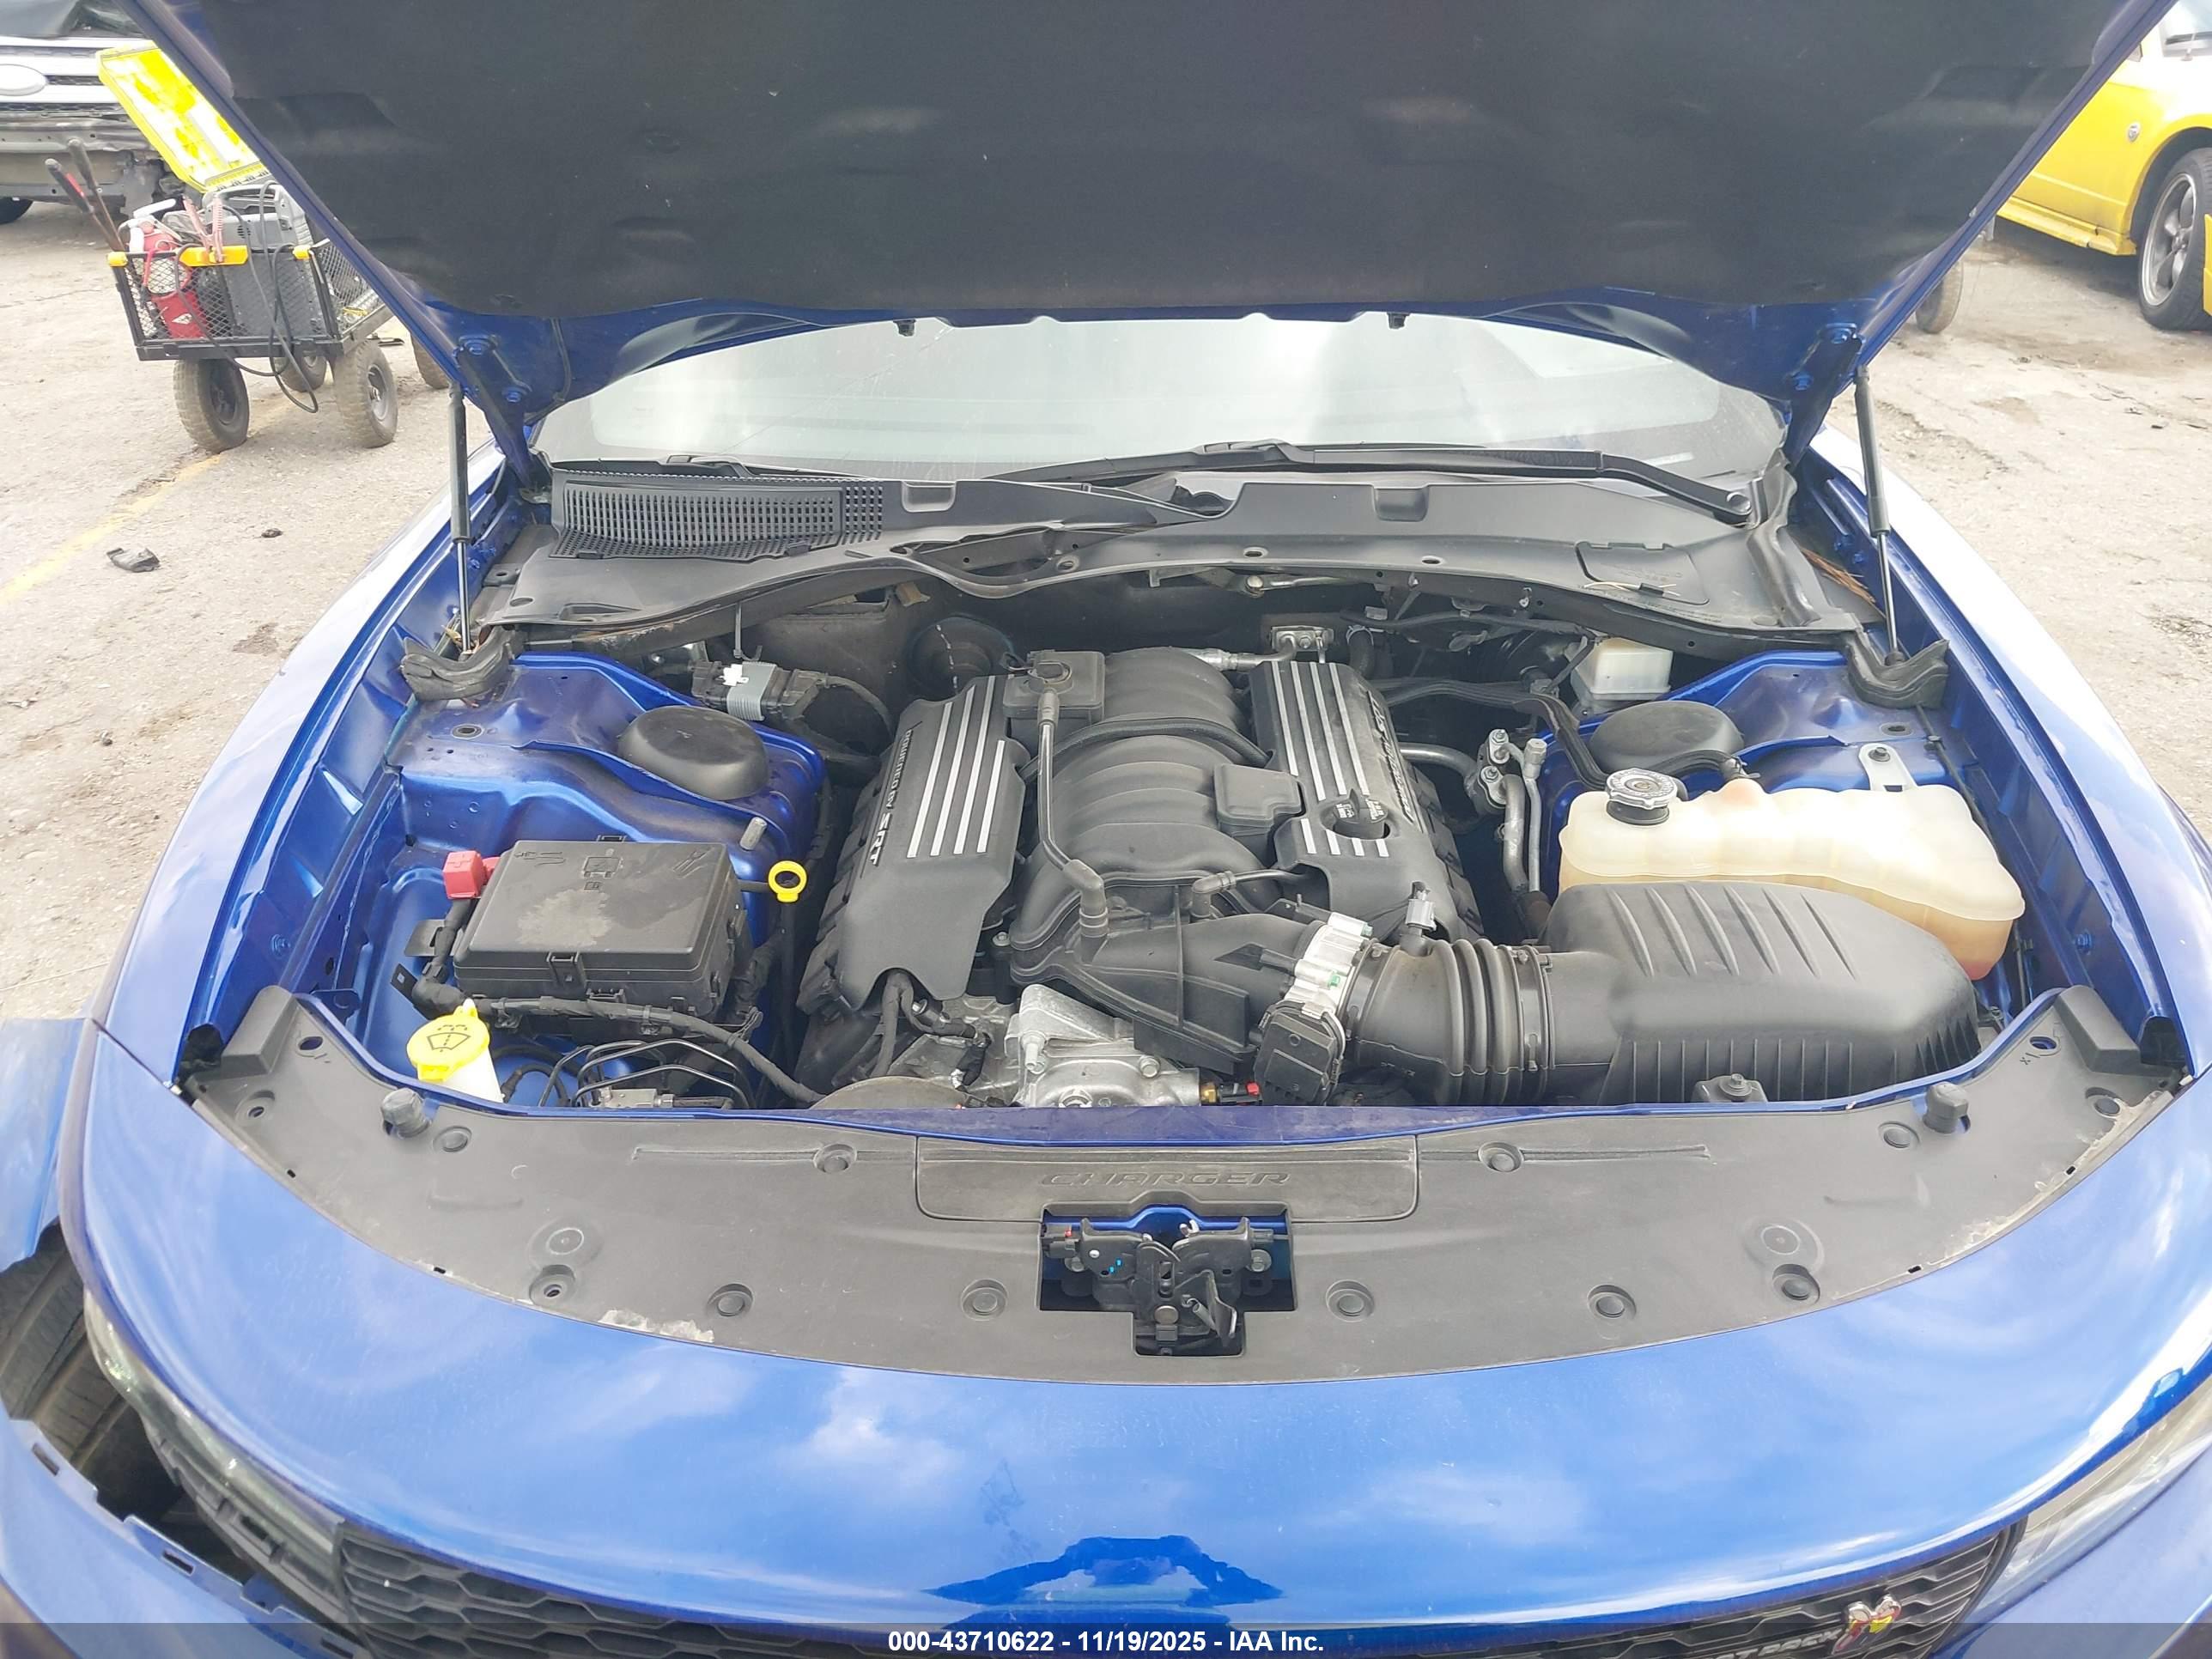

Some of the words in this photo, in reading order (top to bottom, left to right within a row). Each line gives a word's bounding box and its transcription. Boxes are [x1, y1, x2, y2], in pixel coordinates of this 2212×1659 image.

[870, 811, 892, 866] SRT
[1042, 1172, 1291, 1186] CHARGER
[1758, 1627, 1843, 1656] PACK
